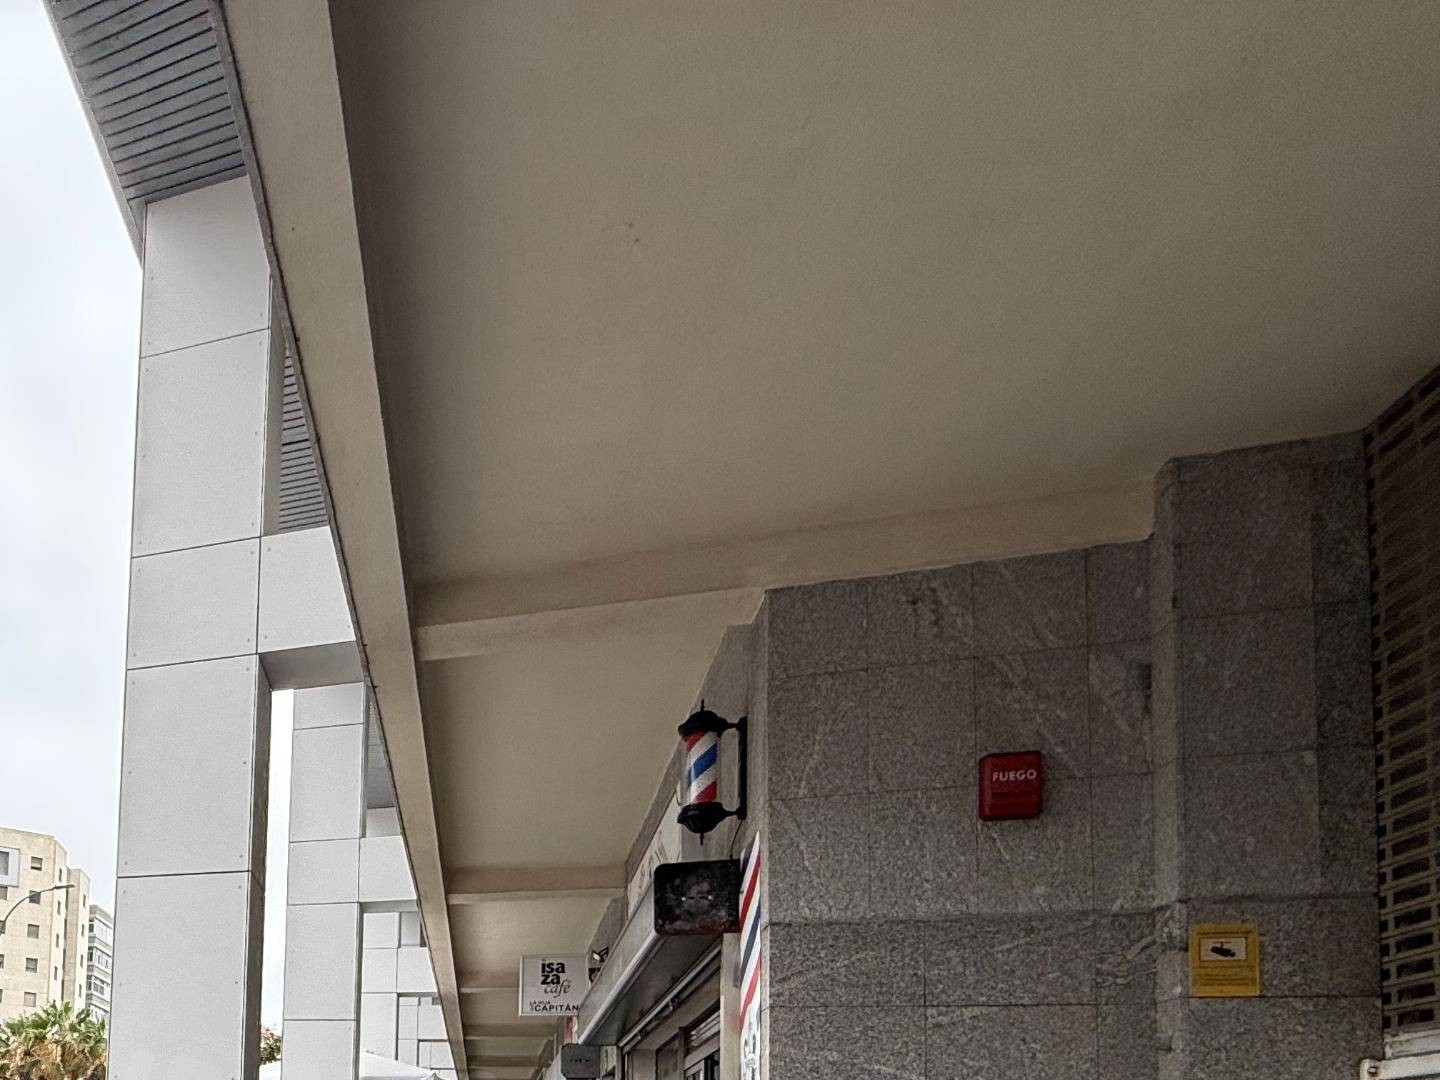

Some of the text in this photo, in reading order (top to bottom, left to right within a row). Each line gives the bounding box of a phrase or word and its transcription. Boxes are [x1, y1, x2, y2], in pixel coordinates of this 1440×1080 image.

[992, 768, 1037, 782] FUEGO
[541, 958, 566, 974] isa
[541, 974, 561, 985] za
[534, 1003, 579, 1012] CAPITÁN
